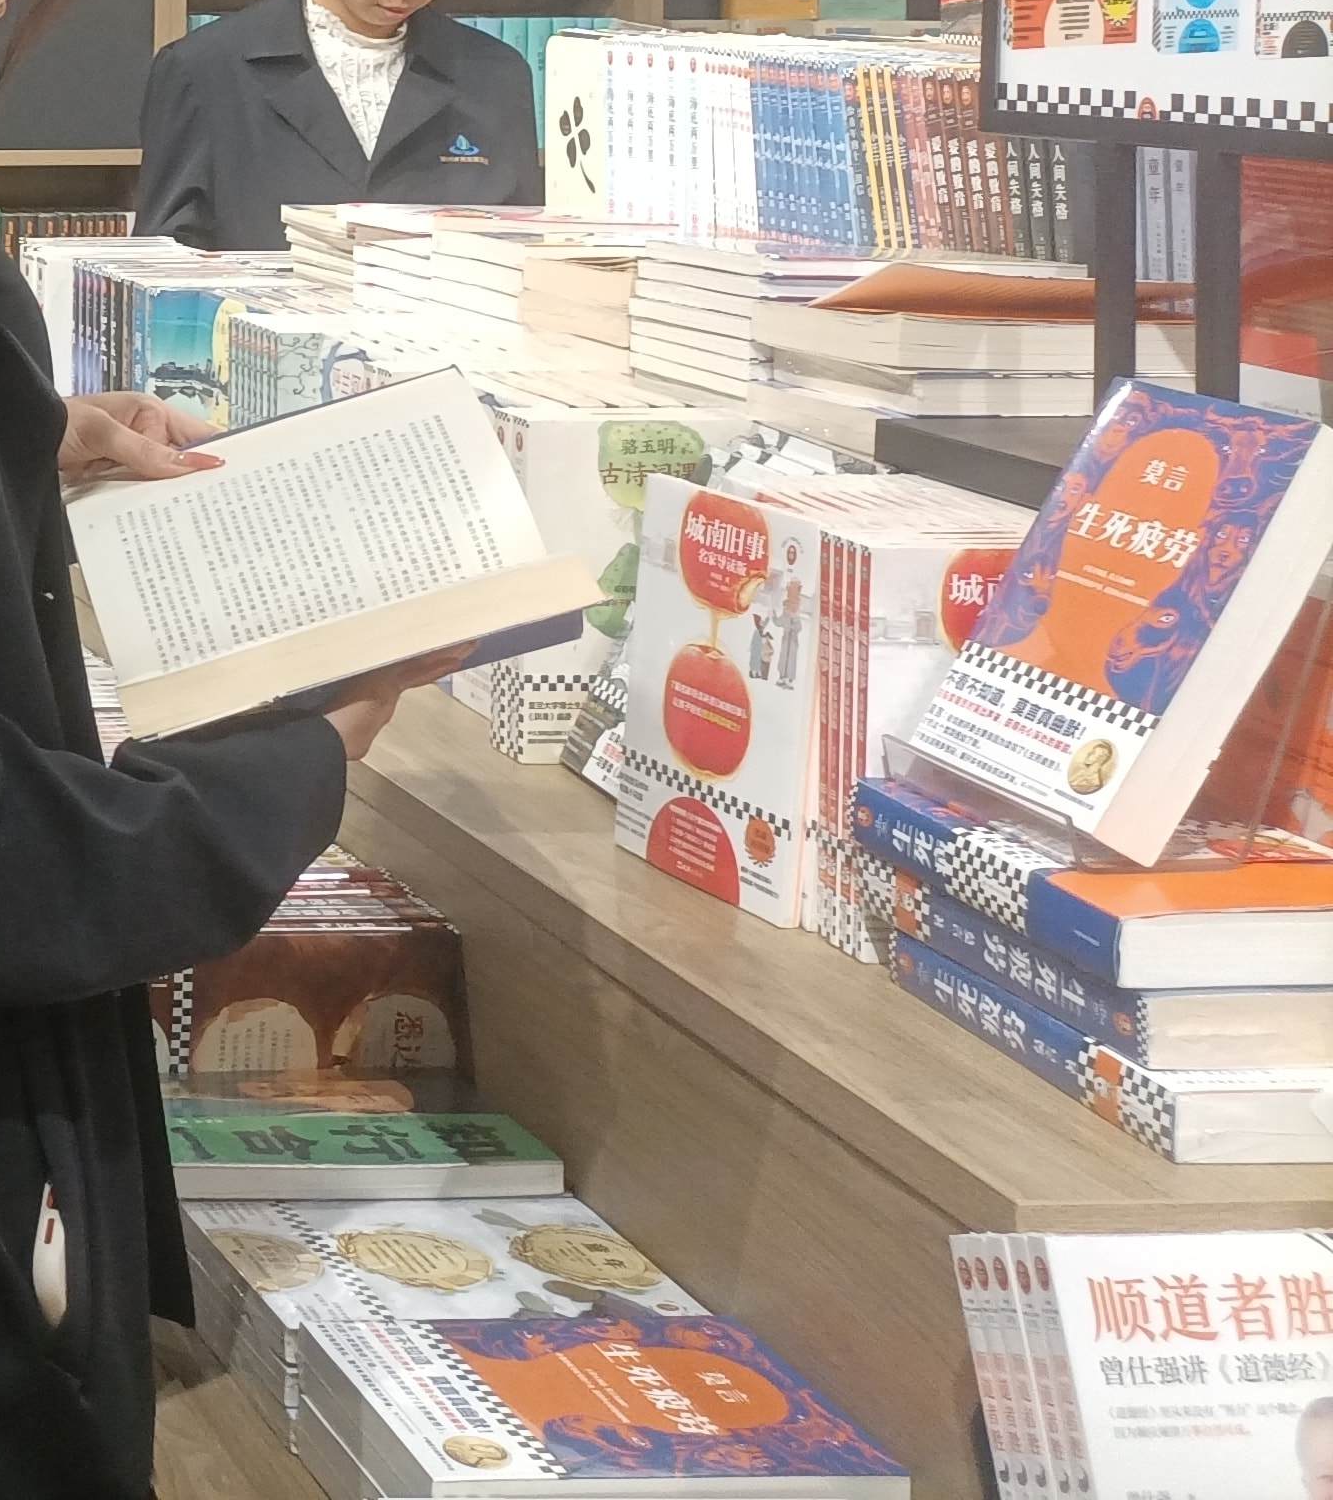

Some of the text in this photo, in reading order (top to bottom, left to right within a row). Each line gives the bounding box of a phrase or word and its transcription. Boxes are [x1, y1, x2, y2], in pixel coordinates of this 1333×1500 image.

[1139, 458, 1190, 492] 莫言
[684, 510, 767, 561] 城南旧事
[1067, 501, 1202, 569] 生死疲劳
[1085, 1271, 1333, 1344] 顺道者胜
[593, 1342, 721, 1436] 生死疲劳
[694, 1370, 751, 1405] 莫言
[1099, 1354, 1331, 1387] 曾仕强讲《道德经》
